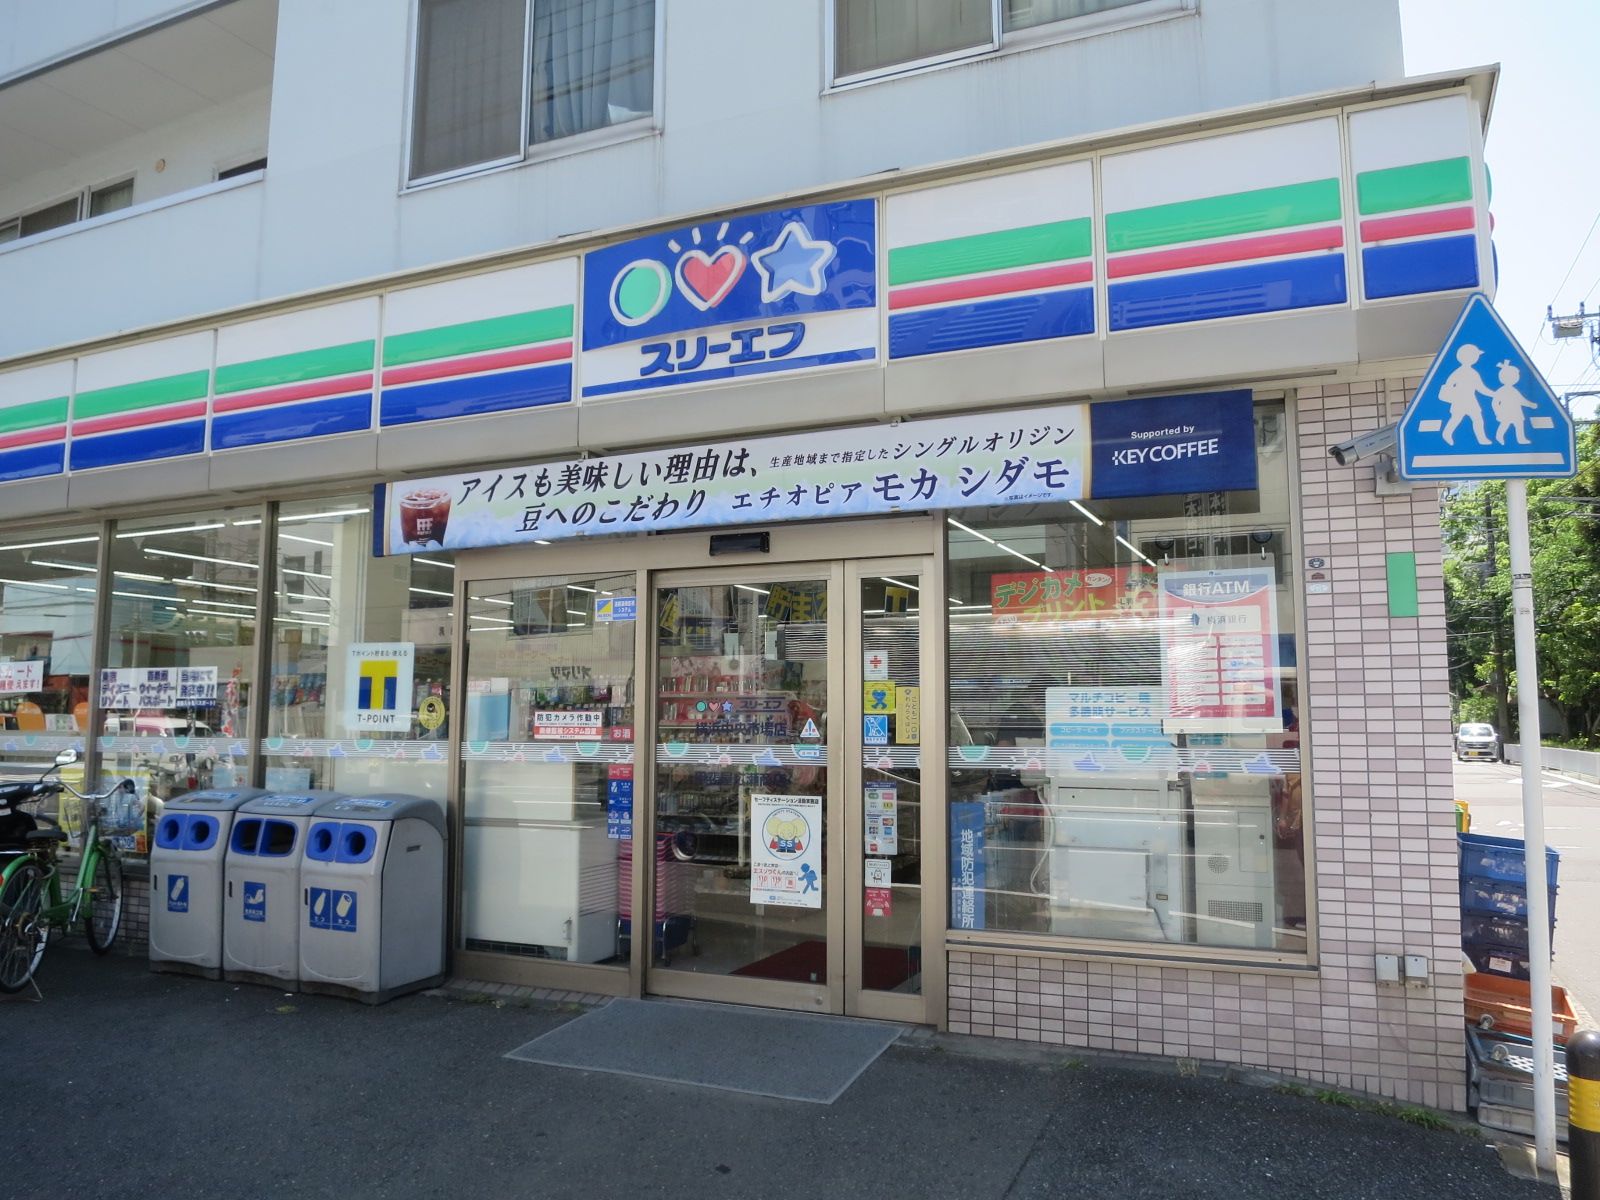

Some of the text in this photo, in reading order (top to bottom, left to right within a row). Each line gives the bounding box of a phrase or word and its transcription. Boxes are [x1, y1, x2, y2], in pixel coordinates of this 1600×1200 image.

[640, 322, 805, 377] スリーエフ
[1131, 425, 1195, 439] Supported by
[457, 448, 757, 506] アイスも美味しい理由は、
[731, 482, 862, 510] エチオピア
[515, 489, 706, 533] 豆へのこだわり
[994, 573, 1083, 608] デジカメ
[1183, 580, 1250, 597] 銀行ATM
[357, 714, 396, 724] T-POINT
[537, 713, 600, 722] 防犯カメラ作動中
[739, 700, 783, 710] スリーエフ
[960, 828, 974, 929] 地域防犯連絡所
